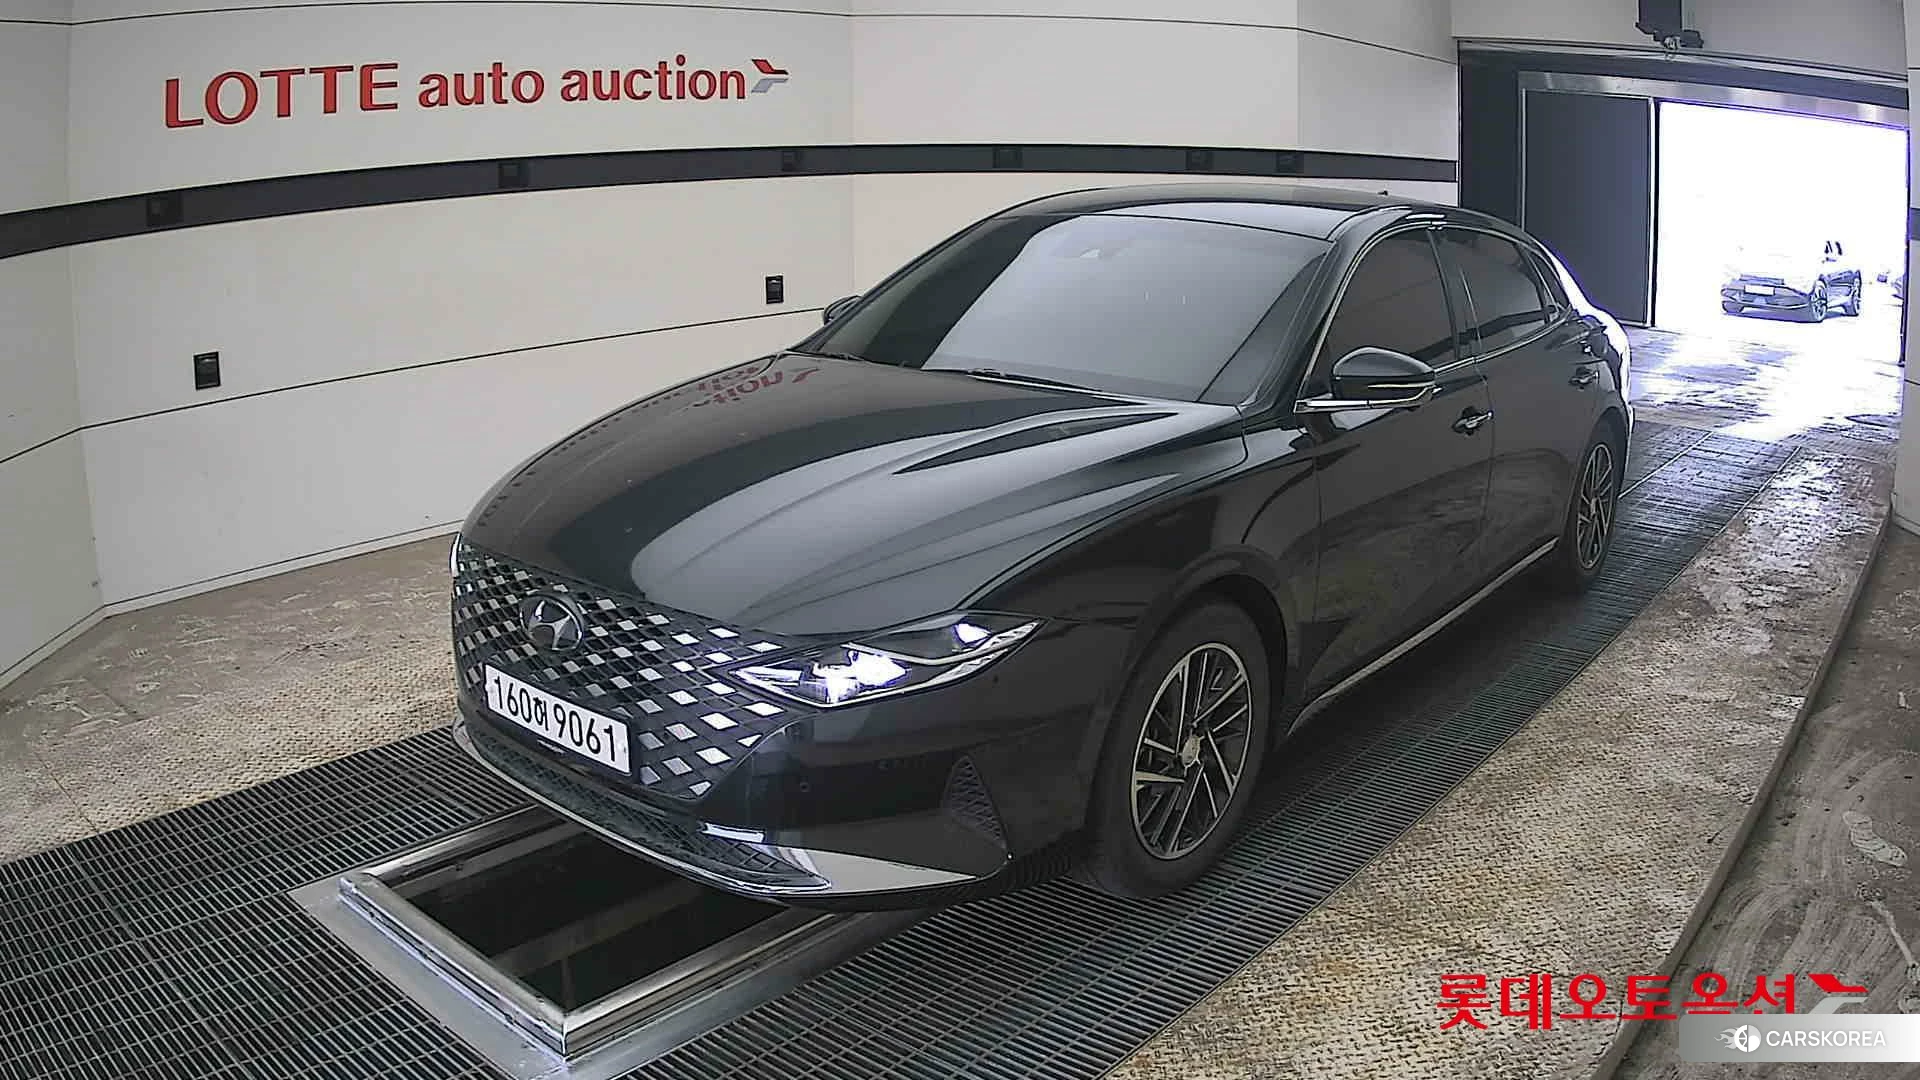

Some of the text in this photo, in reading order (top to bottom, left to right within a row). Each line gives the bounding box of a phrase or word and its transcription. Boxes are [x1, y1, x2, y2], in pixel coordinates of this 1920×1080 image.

[164, 54, 748, 128] LOTTE auto auction
[553, 703, 617, 763] 9061
